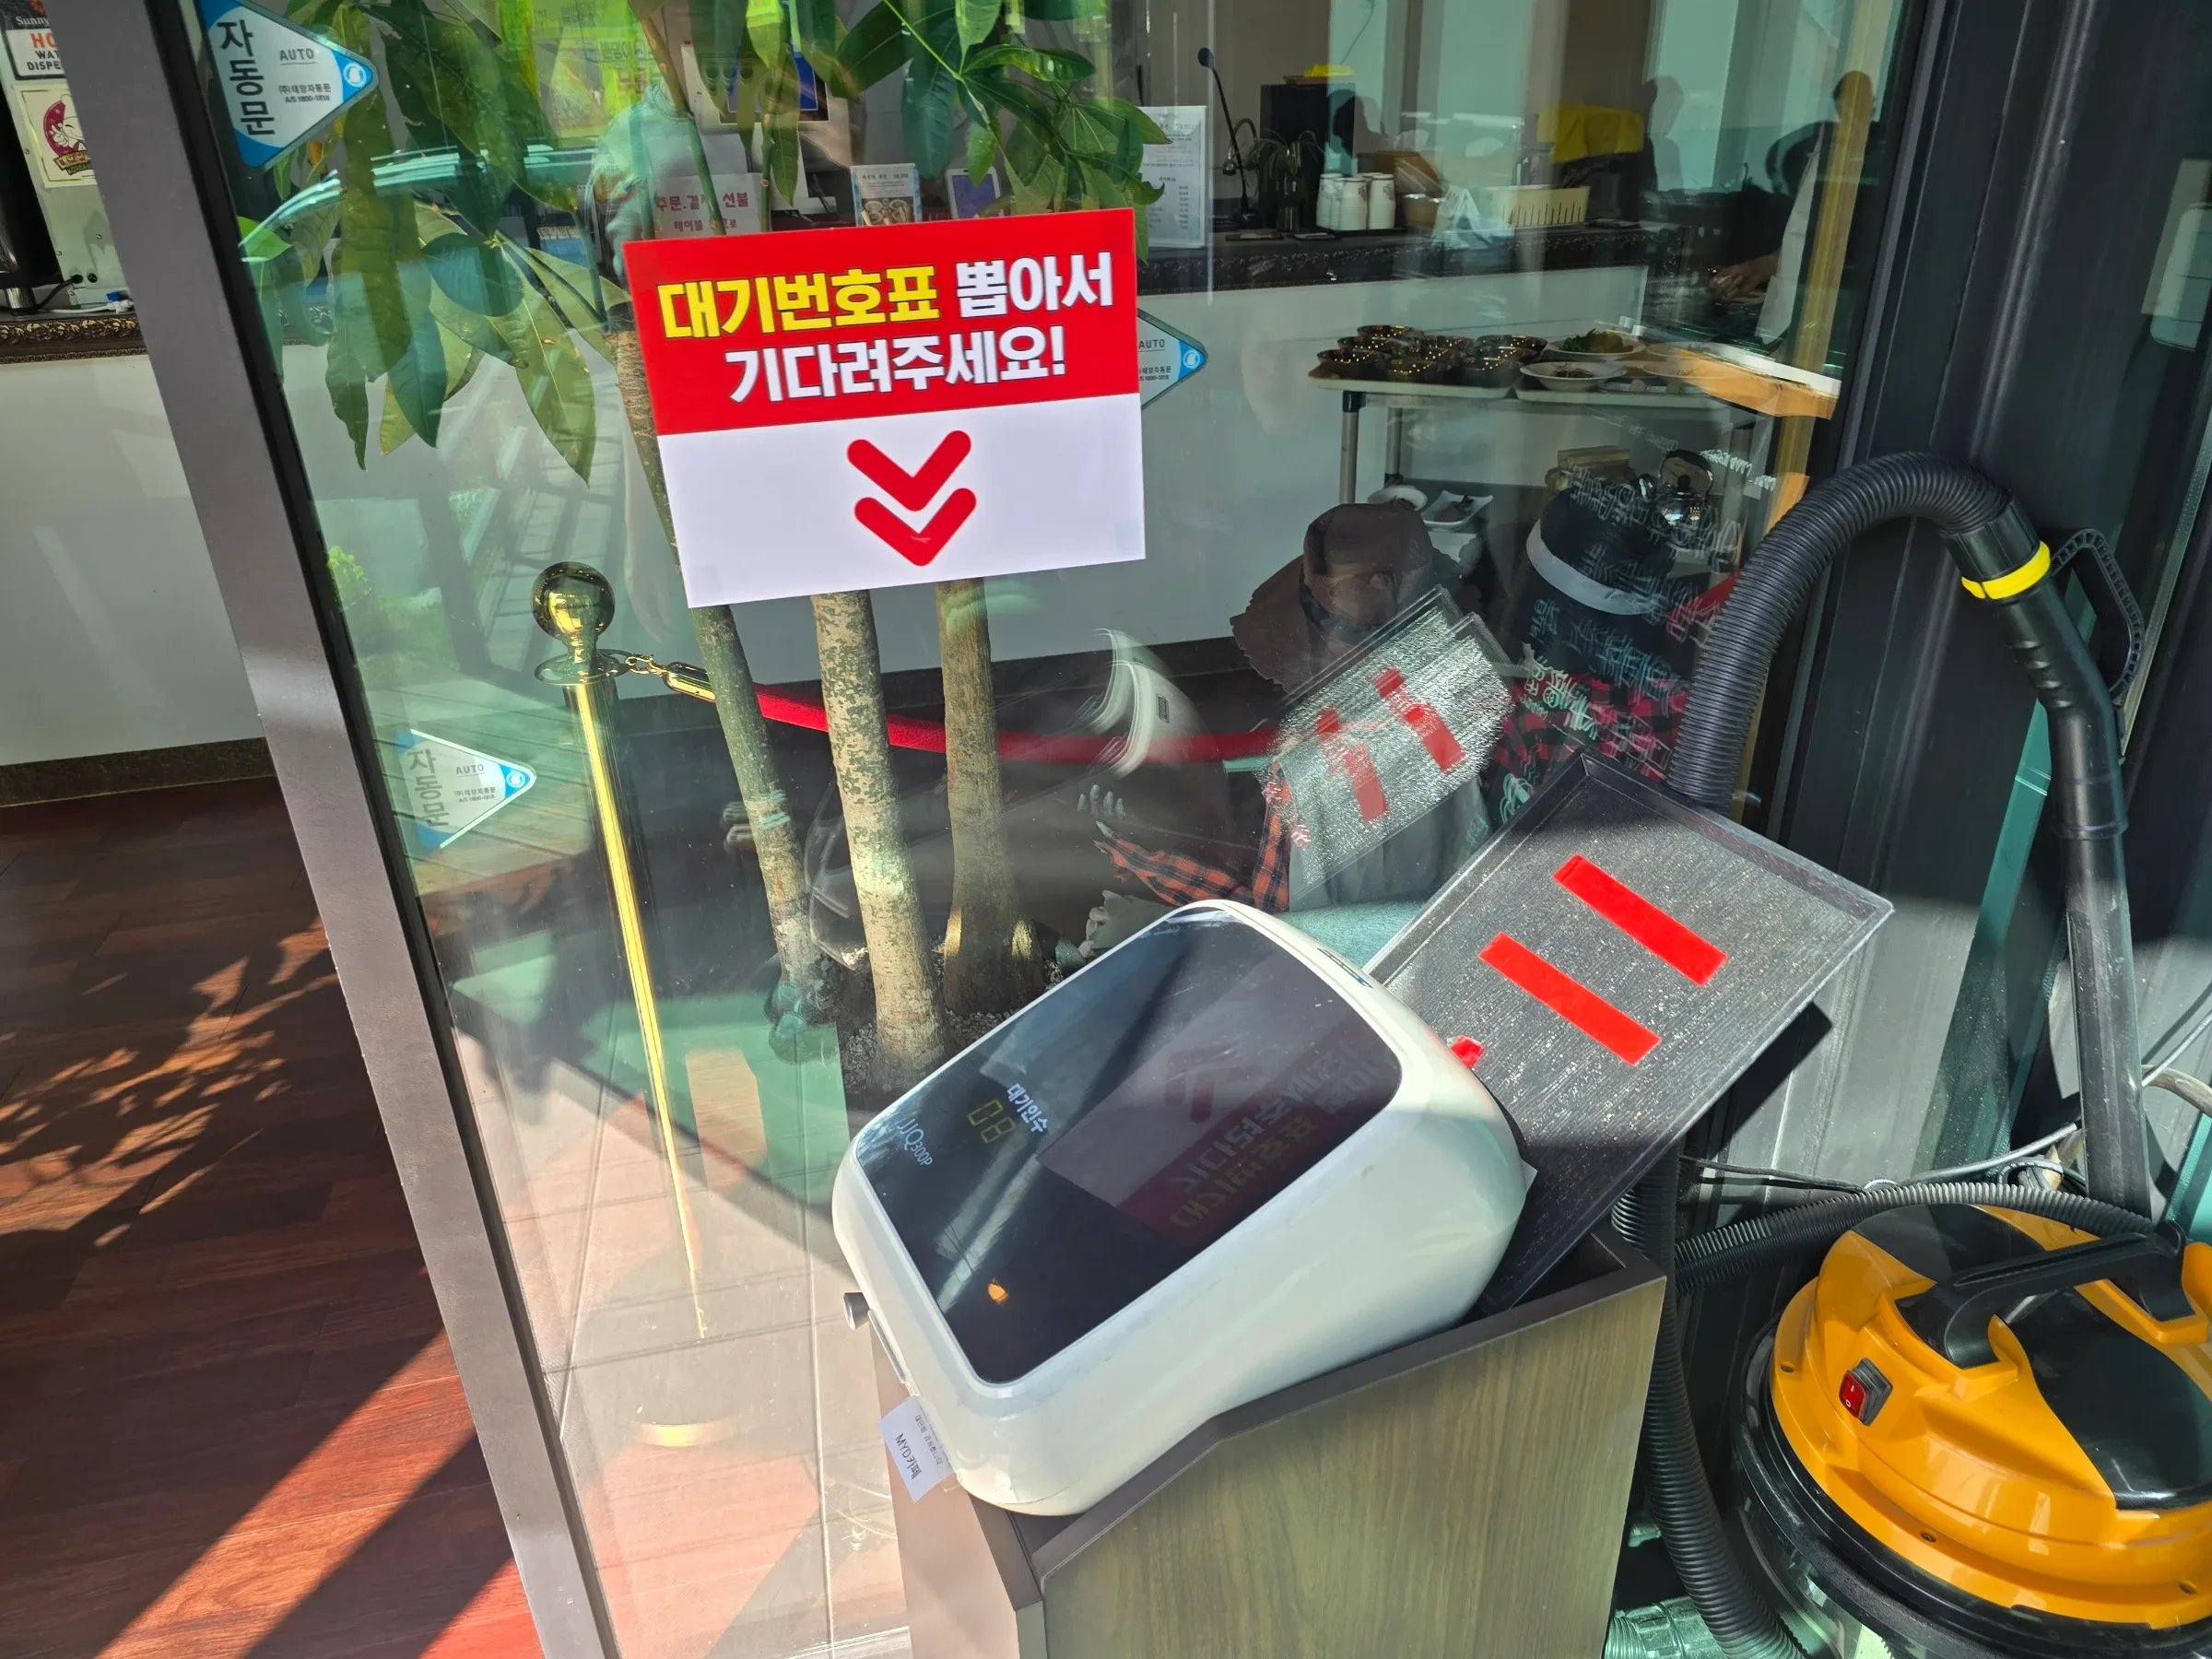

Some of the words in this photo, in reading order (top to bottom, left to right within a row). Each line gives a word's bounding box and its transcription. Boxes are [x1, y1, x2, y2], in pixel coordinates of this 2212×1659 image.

[30, 32, 58, 49] HO
[35, 50, 61, 60] WA
[279, 48, 315, 62] AUTO
[27, 60, 62, 71] DISPE
[217, 18, 276, 135] 자동문
[655, 194, 708, 212] 주문.결
[723, 192, 748, 208] 선불
[674, 219, 703, 232] 테이블
[656, 266, 940, 339] 대기번호표
[955, 251, 1114, 319] 뽑아서
[1138, 338, 1165, 349] AUTO
[724, 325, 1065, 403] 기다려주세요!
[455, 763, 485, 775] AUTO
[406, 748, 450, 827] 자동문
[1006, 1083, 1049, 1133] 대기인수
